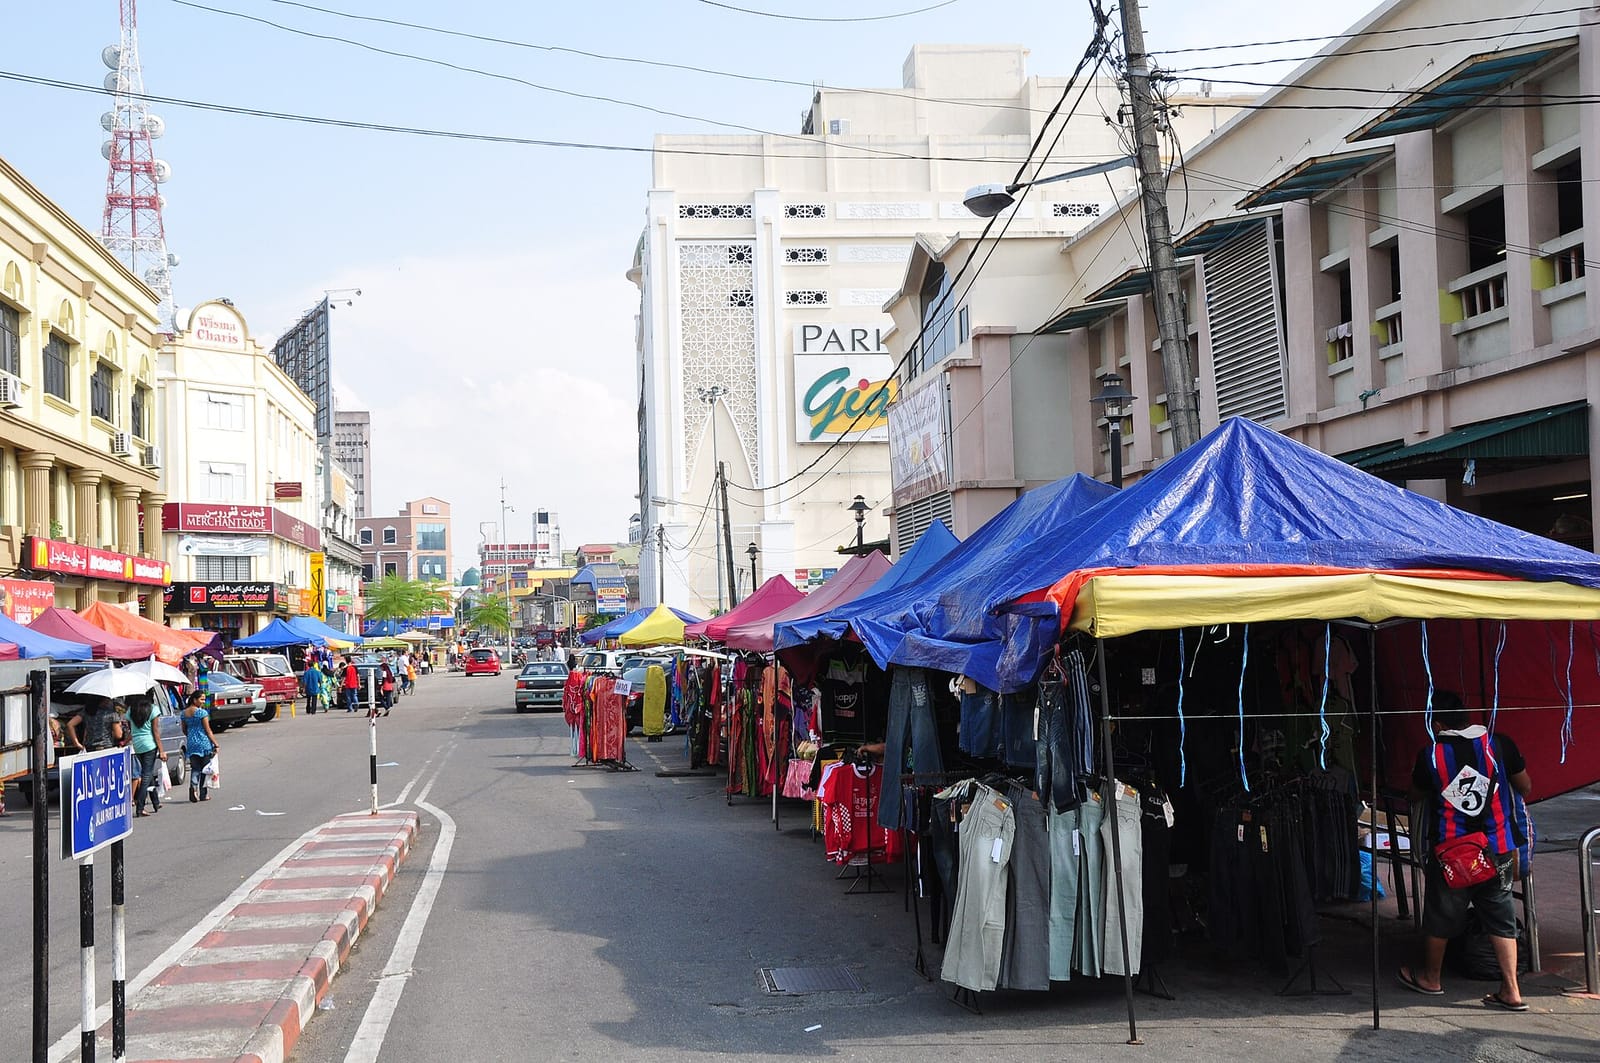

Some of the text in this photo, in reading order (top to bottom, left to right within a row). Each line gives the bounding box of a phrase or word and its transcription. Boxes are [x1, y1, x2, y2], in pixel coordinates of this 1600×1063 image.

[198, 316, 236, 331] Wisma
[197, 329, 239, 344] Charis
[186, 516, 267, 528] MERCHANTRADE
[76, 764, 93, 822] دالم
[1458, 775, 1483, 812] 3
